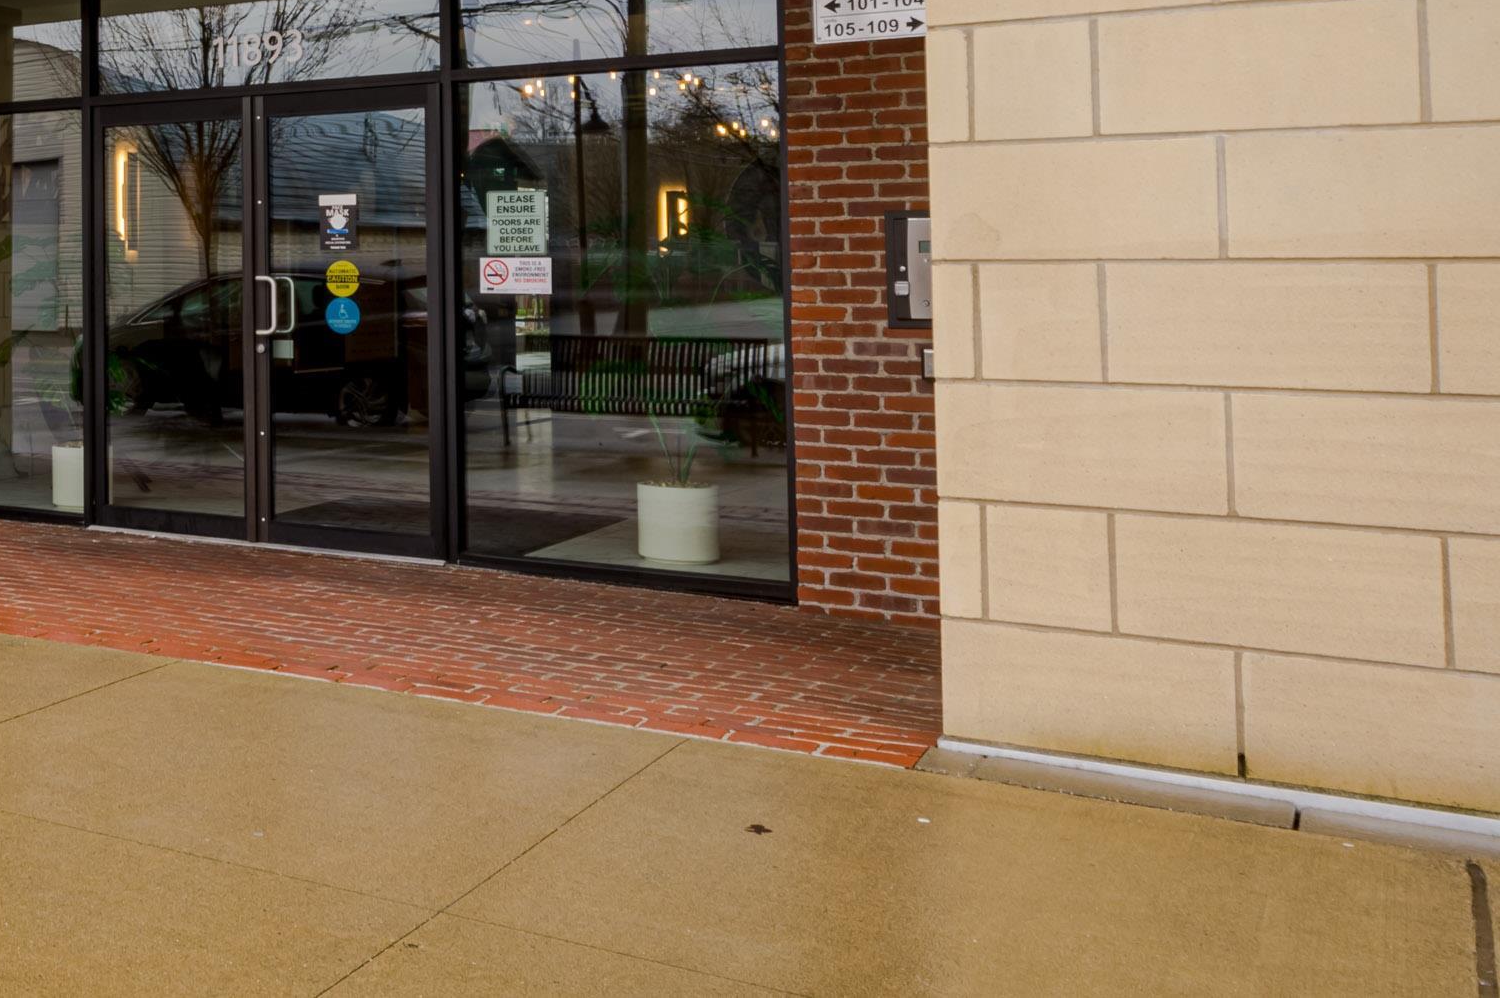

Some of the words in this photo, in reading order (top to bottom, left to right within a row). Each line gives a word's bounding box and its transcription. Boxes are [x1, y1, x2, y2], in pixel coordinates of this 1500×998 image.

[824, 19, 899, 37] 105-109
[212, 29, 303, 68] 11893
[497, 195, 535, 204] PLEASE
[326, 208, 349, 217] MASK
[496, 205, 536, 214] ENSURE
[523, 218, 541, 226] ARE
[500, 236, 534, 244] BEFORE
[327, 275, 358, 283] CAUTION
